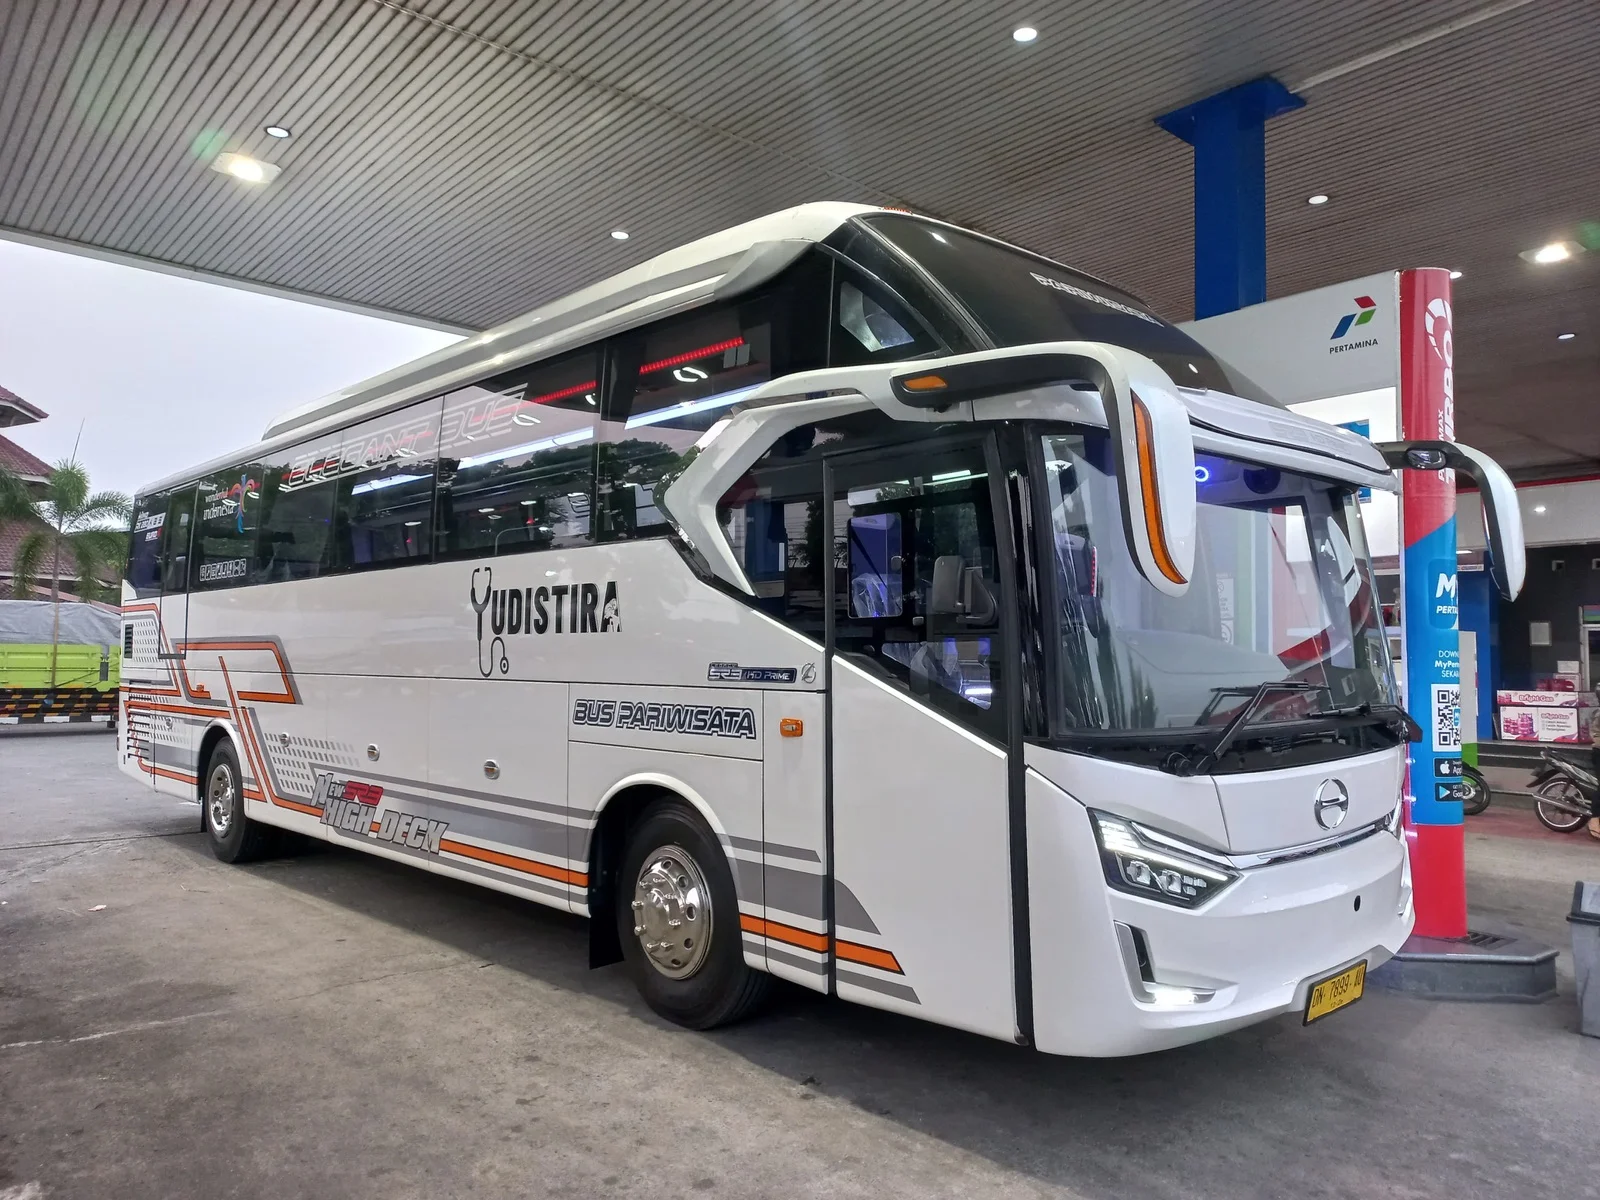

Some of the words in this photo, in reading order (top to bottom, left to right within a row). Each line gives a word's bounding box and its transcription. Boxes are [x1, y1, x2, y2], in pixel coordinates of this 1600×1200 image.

[1329, 338, 1379, 355] PERTAMINA
[287, 420, 432, 489] ELEGANT
[434, 392, 525, 447] BUS
[470, 566, 623, 678] YUDISTIRA
[746, 670, 762, 679] HD
[763, 671, 791, 680] PRIME
[1519, 694, 1540, 703] Bright
[573, 698, 617, 726] BUS
[615, 701, 757, 740] PARIWISATA
[320, 798, 378, 836] HIGH
[376, 809, 451, 855] DECK
[1329, 974, 1350, 1000] 7899
